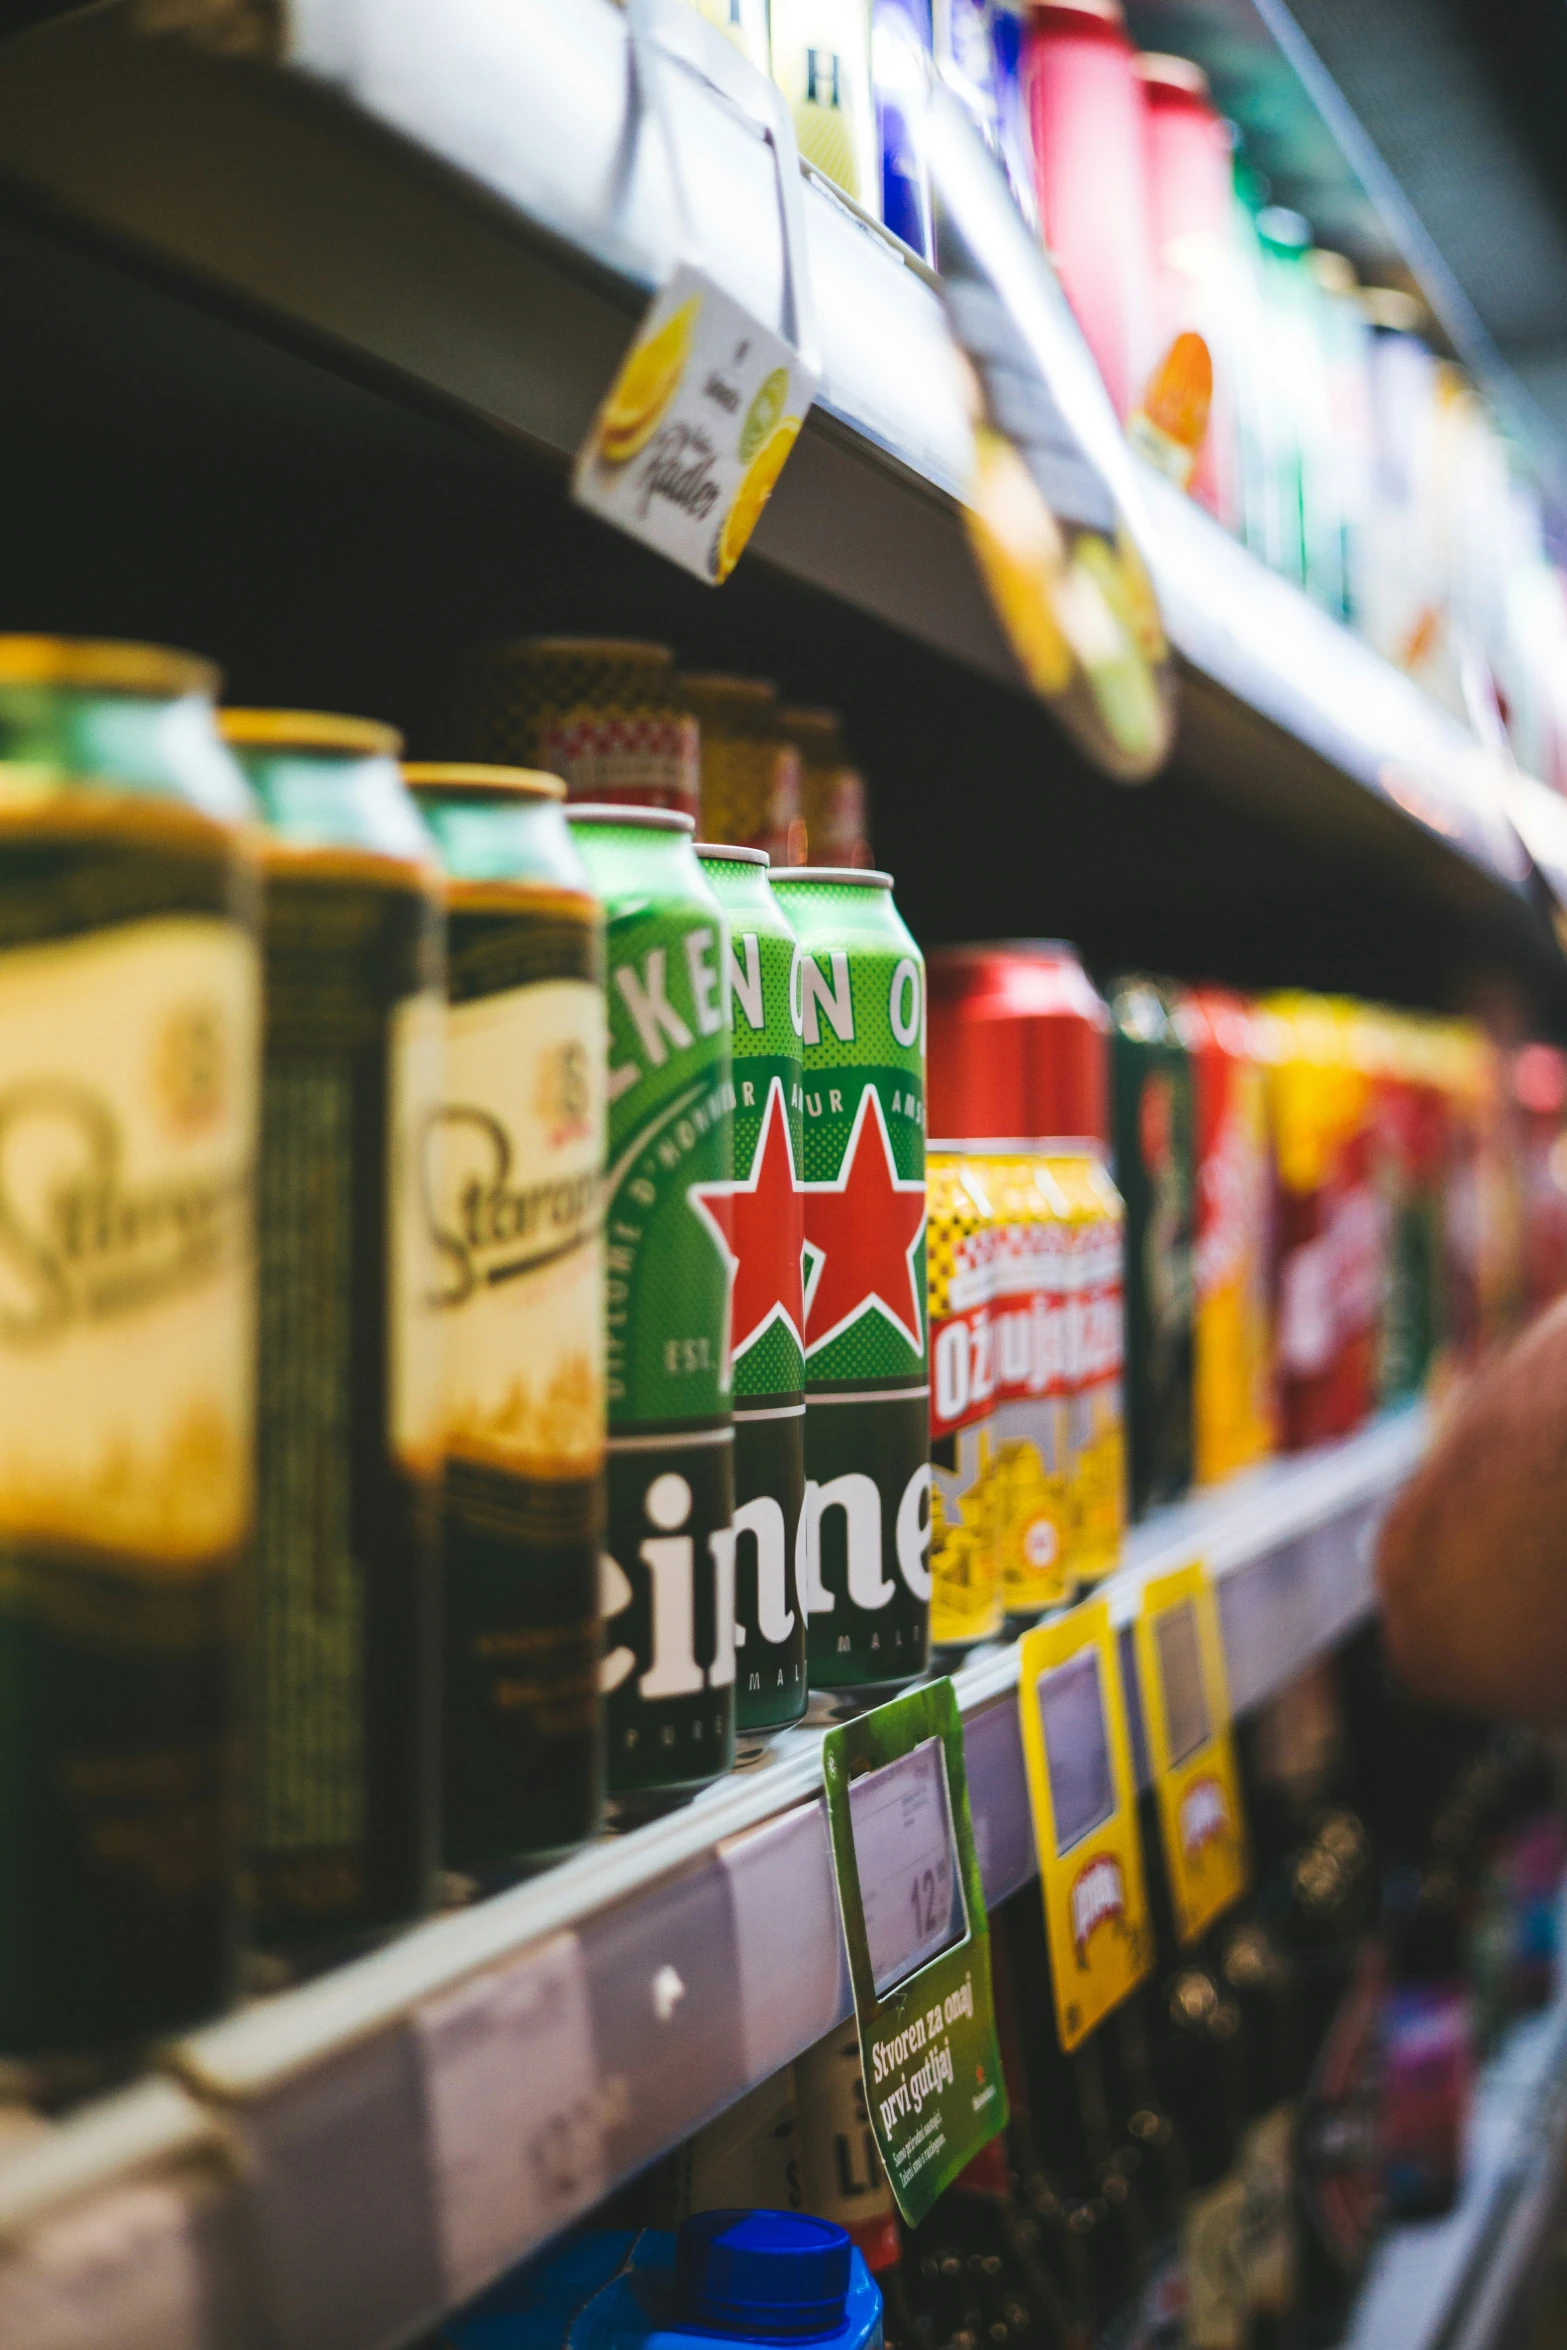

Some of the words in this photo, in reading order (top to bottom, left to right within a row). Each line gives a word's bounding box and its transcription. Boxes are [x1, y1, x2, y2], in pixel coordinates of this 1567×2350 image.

[871, 2016, 927, 2085] Stvoren
[926, 2003, 944, 2040] za
[944, 1970, 974, 2026] onaj
[879, 2072, 912, 2142] prvi
[910, 2036, 954, 2115] gutljaj
